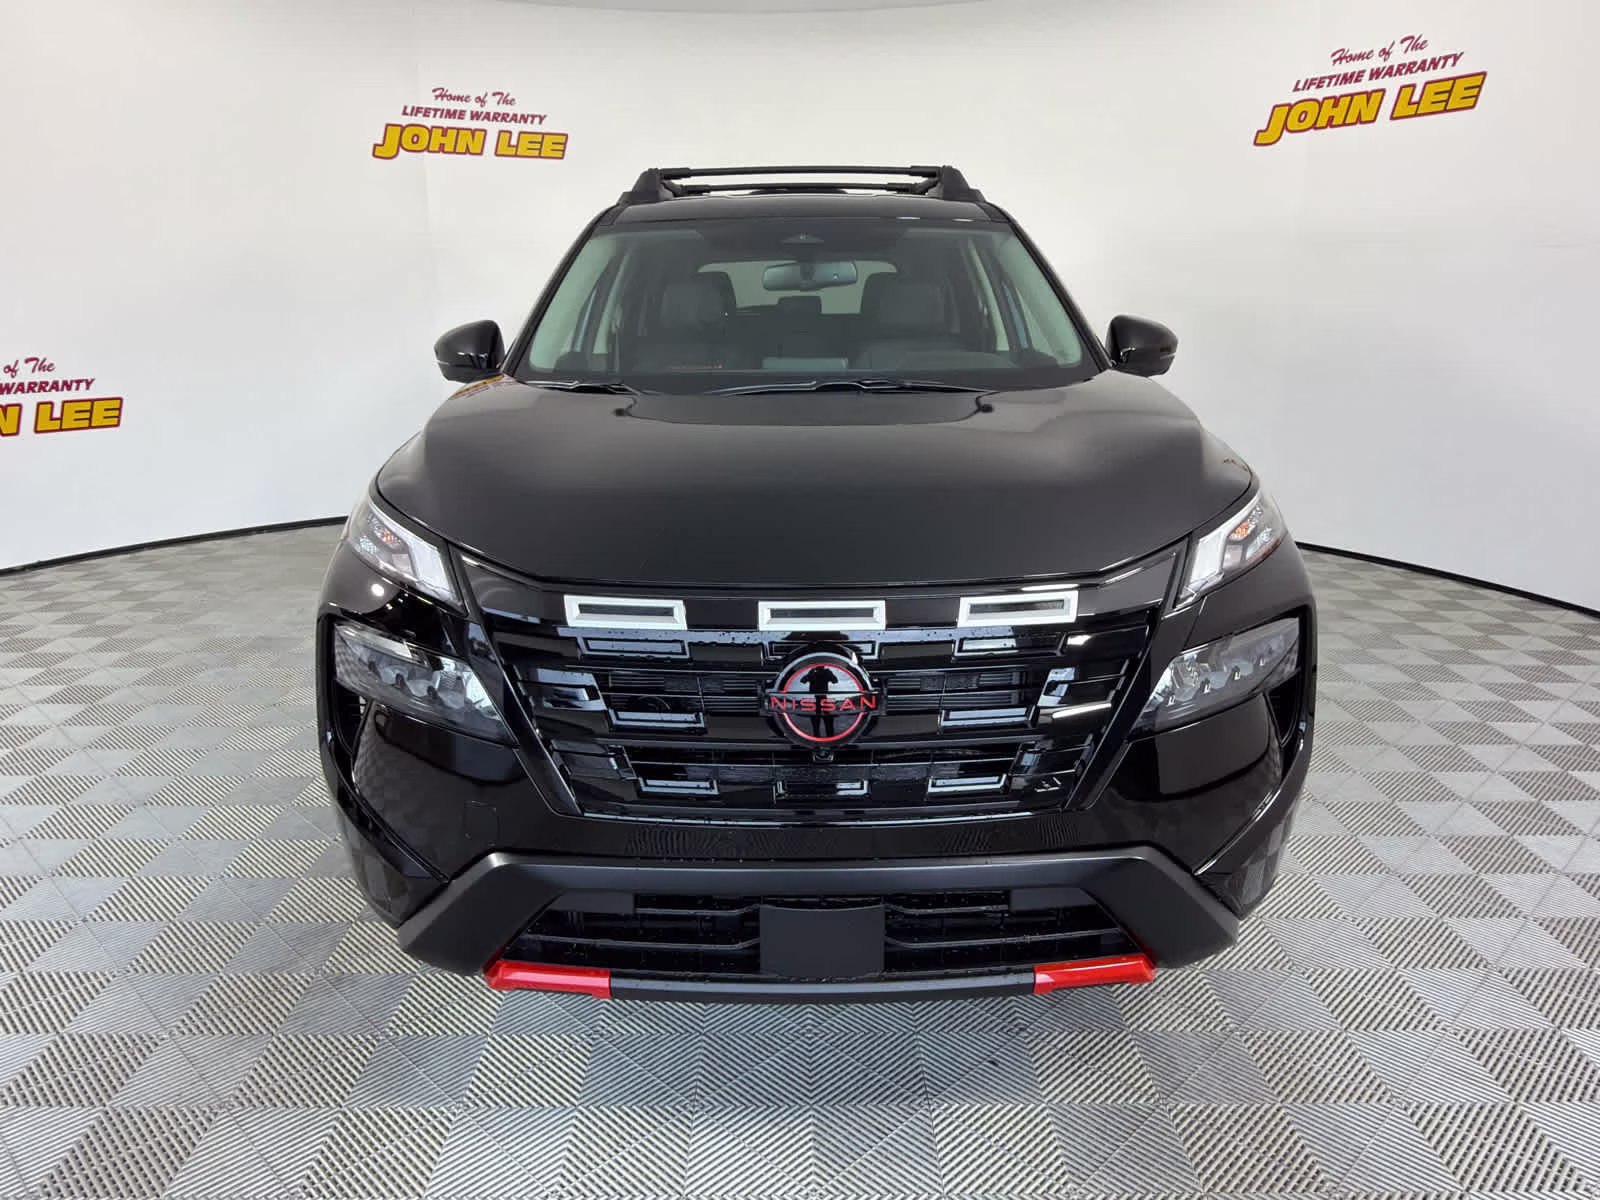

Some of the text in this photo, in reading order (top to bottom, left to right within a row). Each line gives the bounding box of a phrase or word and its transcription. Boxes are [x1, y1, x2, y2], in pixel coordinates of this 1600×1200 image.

[1331, 34, 1428, 66] Home of The
[1292, 52, 1464, 92] LIFETIME WARRANTY
[432, 88, 516, 107] Home of The
[1254, 71, 1487, 146] JOHN LEE
[402, 105, 547, 125] LIFETIME WARRANTY
[372, 123, 568, 160] JOHN LEE
[3, 357, 55, 378] of The
[0, 378, 95, 395] WARRANTY
[34, 397, 123, 434] LEE
[769, 696, 877, 712] NISSAN
